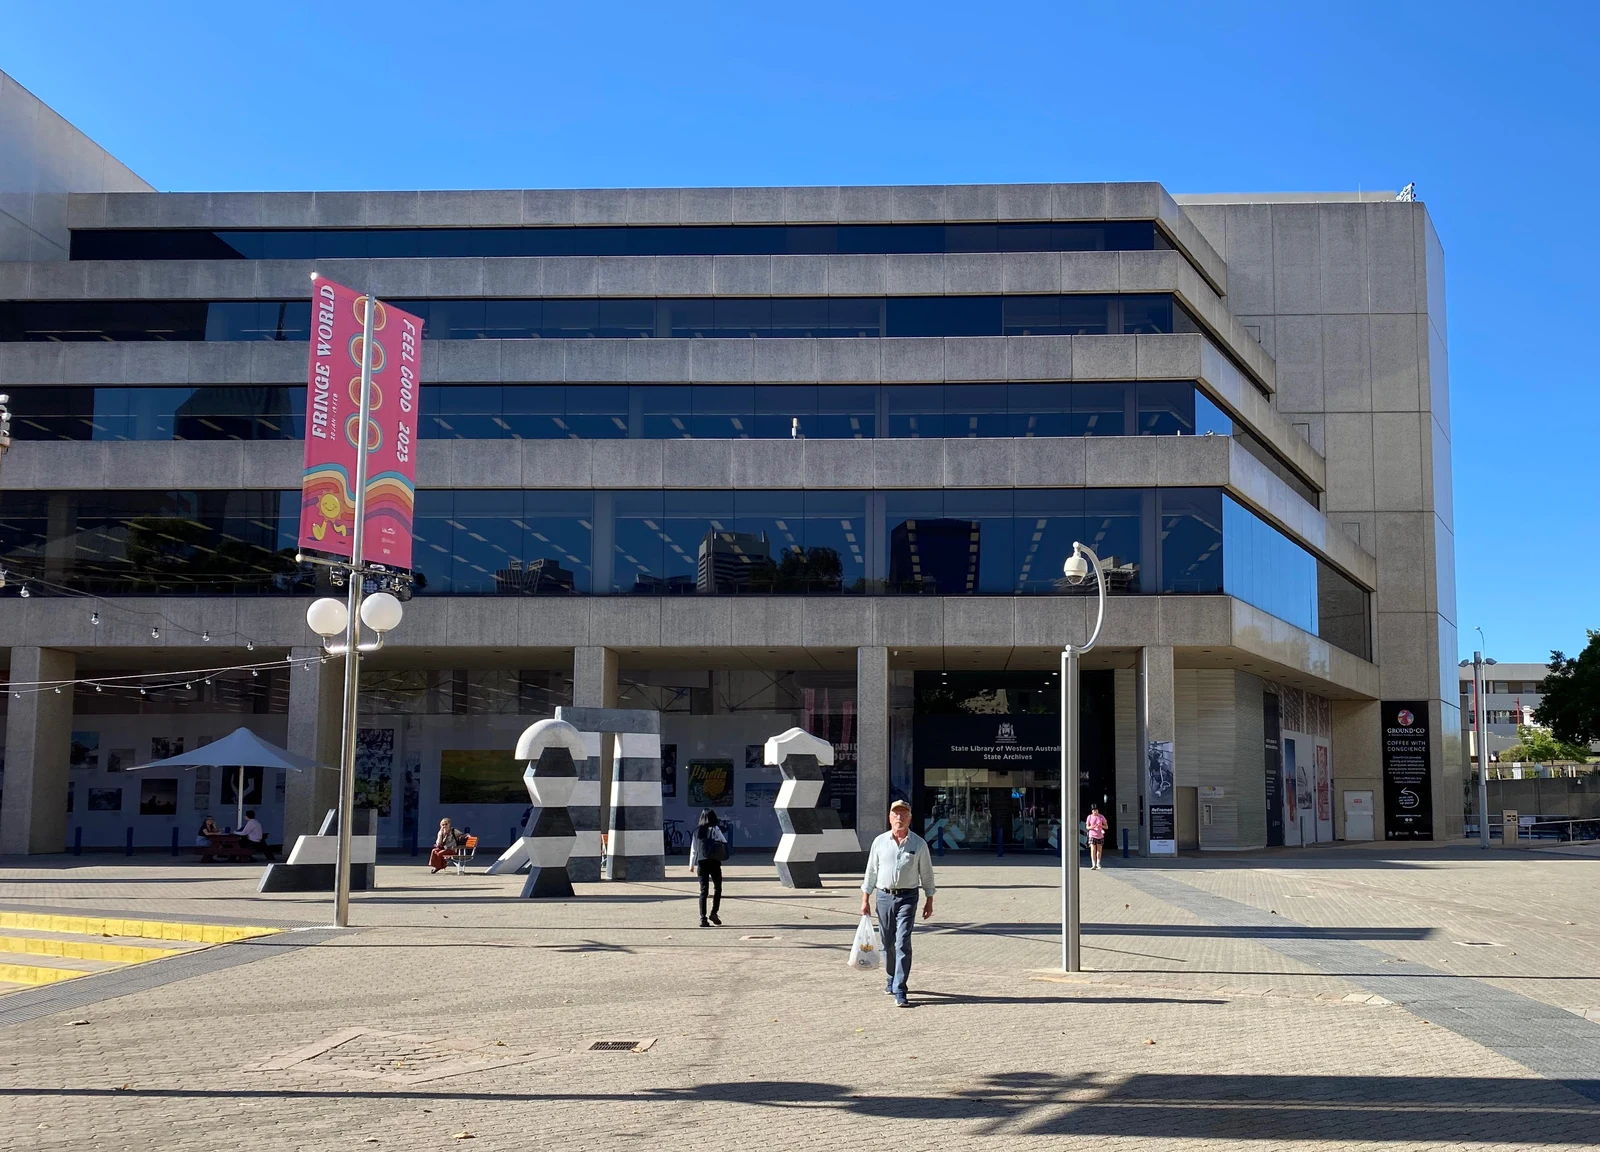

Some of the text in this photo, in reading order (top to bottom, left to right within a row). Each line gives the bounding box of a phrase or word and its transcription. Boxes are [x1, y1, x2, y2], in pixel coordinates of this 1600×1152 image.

[312, 285, 334, 439] FRINGE WORLD
[396, 318, 415, 463] FEEL GOOD 2023
[970, 745, 995, 753] Library
